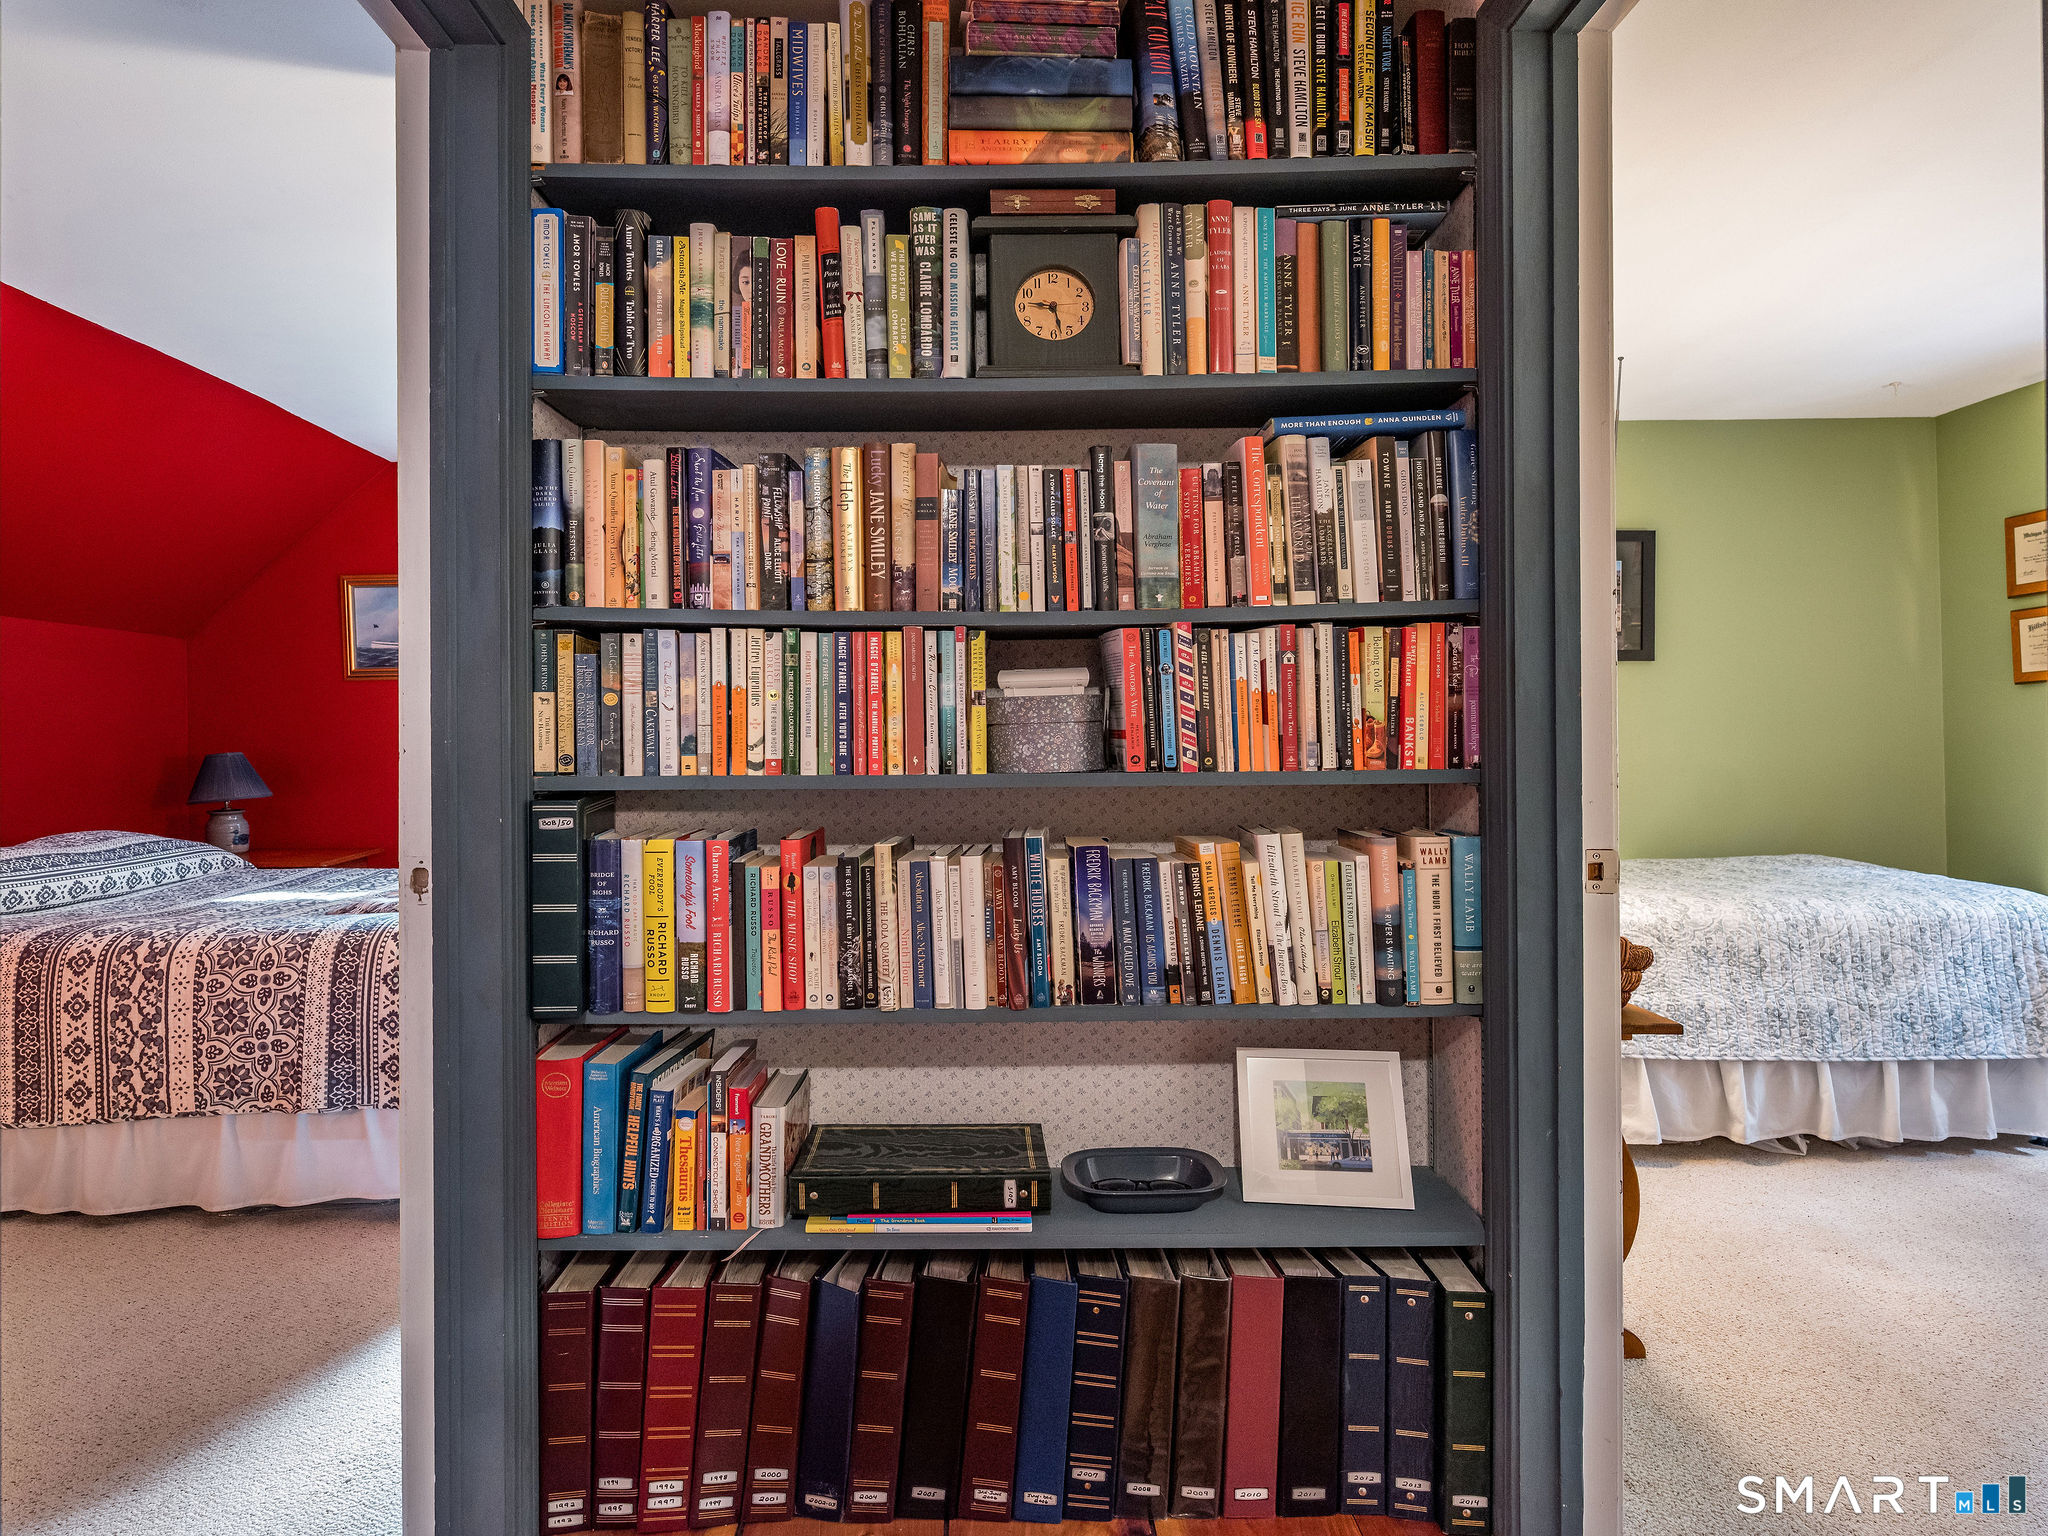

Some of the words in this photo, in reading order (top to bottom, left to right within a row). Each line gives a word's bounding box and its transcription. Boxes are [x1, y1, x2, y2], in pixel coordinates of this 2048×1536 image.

[651, 3, 660, 40] HARPER
[1184, 6, 1195, 40] COLD
[1224, 4, 1234, 30] NORTH
[1291, 2, 1305, 19] ICE
[897, 10, 906, 69] BOHJALIAN
[907, 24, 915, 56] CHRIS
[1225, 32, 1235, 42] OF
[1292, 22, 1305, 43] RUN
[1366, 10, 1374, 50] SECOND
[651, 46, 660, 63] LEE
[693, 23, 703, 70] Mockingbird
[792, 29, 804, 96] MIDWIVES
[1188, 44, 1202, 110] MOUNTAIN
[1226, 45, 1237, 84] NOWHERE
[1293, 49, 1306, 77] STEVE
[1366, 53, 1374, 73] LIFE
[1295, 80, 1308, 127] HAMILTON
[1365, 85, 1374, 108] NICK
[1365, 112, 1374, 149] MASON
[913, 212, 937, 222] SAME
[913, 223, 923, 233] AS
[926, 223, 937, 232] IT
[949, 213, 958, 244] CELESTE
[625, 224, 634, 249] Amor
[914, 235, 936, 244] EVER
[915, 246, 936, 255] WAS
[626, 251, 634, 281] Towles
[678, 240, 686, 279] Astonish
[776, 242, 786, 269] LOVE
[950, 247, 958, 259] NG
[679, 280, 686, 295] Me
[776, 278, 786, 303] RUIN
[920, 262, 931, 296] CLAIRE
[1022, 288, 1032, 298] 10
[1034, 278, 1040, 288] 11
[1048, 274, 1058, 284] 12
[1076, 288, 1083, 297] 2
[1170, 262, 1179, 298] ANNE
[626, 300, 635, 322] Table
[1018, 302, 1025, 312] 9
[1024, 316, 1031, 326] 8
[1078, 316, 1084, 325] 4
[1082, 302, 1089, 312] 3
[626, 326, 635, 338] for
[920, 302, 932, 356] LOMBARDO
[950, 320, 958, 351] HEARTS
[1036, 326, 1042, 335] 7
[1050, 329, 1057, 339] 6
[1066, 326, 1072, 336] 5
[1172, 305, 1181, 345] TYLER
[626, 340, 635, 359] Two
[868, 450, 885, 487] Lucky
[1251, 446, 1262, 464] The
[843, 463, 851, 478] The
[837, 481, 853, 511] Help
[870, 490, 884, 523] JANE
[1146, 502, 1168, 510] Water
[1251, 469, 1265, 548] Correspondent
[649, 531, 658, 552] Being
[870, 527, 886, 579] SMILEY
[838, 636, 846, 660] MAGGIE
[1371, 636, 1382, 665] Belong
[1374, 668, 1381, 677] to
[1374, 679, 1382, 692] Me
[646, 709, 657, 758] CAKEWALK
[1405, 717, 1414, 756] BANKS
[712, 845, 722, 883] Chances
[1030, 853, 1042, 884] WHITE
[1085, 849, 1100, 880] FREDRIK
[1205, 861, 1214, 884] SMALL
[1464, 853, 1474, 894] WALLY
[680, 854, 696, 907] Somebody's
[1432, 874, 1440, 888] THE
[788, 899, 796, 919] THE
[1032, 889, 1043, 926] HOUSES
[1087, 883, 1102, 920] BACKMAN
[1207, 886, 1217, 916] MERCIES
[1432, 890, 1440, 910] HOUR
[686, 908, 696, 930] Fool
[1433, 918, 1442, 939] FIRST
[1465, 899, 1475, 932] LAMB
[646, 929, 655, 968] RUSSO
[658, 922, 667, 975] RICHARD
[788, 922, 797, 953] MUSIC
[1211, 929, 1222, 962] DENNIS
[713, 932, 722, 976] RICHARD
[1434, 943, 1442, 978] BELIEVED
[788, 956, 797, 984] SHOP
[1092, 955, 1106, 987] WINNERS
[1216, 966, 1227, 1000] LEHANE
[713, 978, 723, 1007] RUSSO
[593, 1106, 603, 1146] American
[624, 1115, 640, 1157] HELPFUL
[649, 1129, 661, 1178] ORGANIZED
[592, 1148, 602, 1195] Biographies
[622, 1160, 636, 1190] HINTS
[678, 1136, 692, 1202] Thesaurus
[758, 1122, 772, 1216] GRANDMOTHERS
